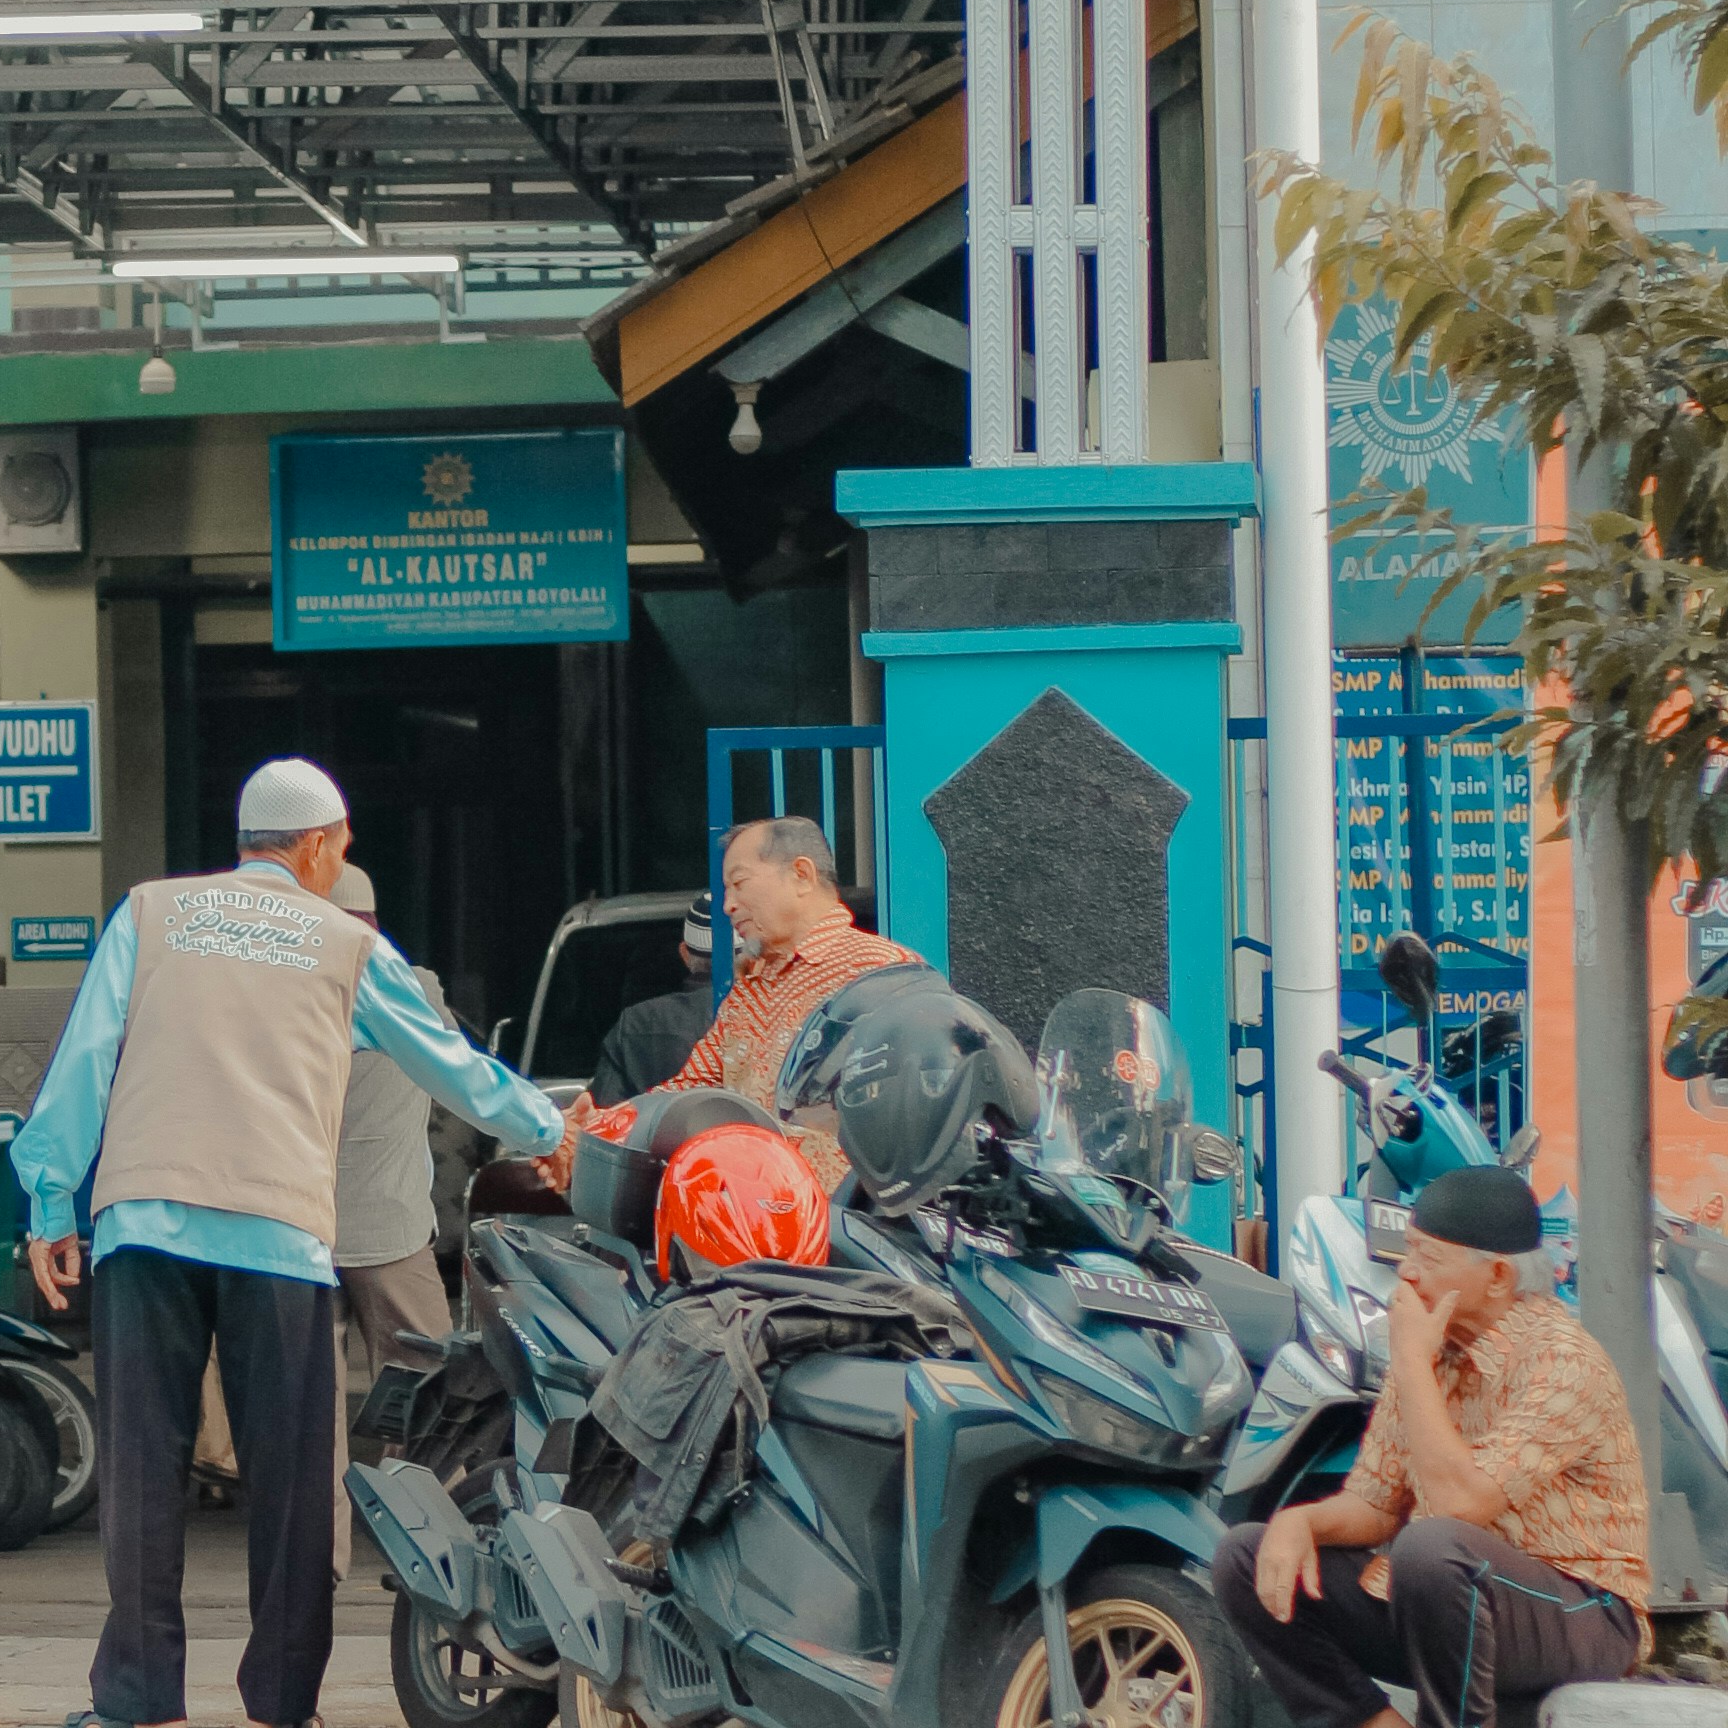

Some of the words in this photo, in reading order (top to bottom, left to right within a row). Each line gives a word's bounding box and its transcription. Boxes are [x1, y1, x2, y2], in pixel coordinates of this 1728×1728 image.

[1357, 406, 1470, 453] MUHAMMADIYAH
[407, 509, 489, 530] KANTOR
[290, 536, 369, 551] KELOMPOK
[373, 533, 457, 550] BIMBINGAN
[460, 532, 516, 547] IBADAH
[519, 530, 555, 545] HAJI
[296, 592, 424, 611] MUHAMMADIYAH
[428, 589, 522, 608] KABUPATEN
[526, 587, 607, 603] BOYOLALI
[1332, 671, 1382, 692] SMP
[174, 889, 254, 912] Kajian
[257, 894, 323, 932] Ahad
[184, 909, 305, 949] Pagimu
[17, 923, 47, 941] AREA
[48, 921, 89, 940] WUDHU
[166, 930, 225, 956] Masjid
[225, 940, 319, 971] Al-Anwar
[1066, 1268, 1099, 1290] AD
[1106, 1277, 1166, 1304] 4241
[1169, 1287, 1208, 1311] DH
[1276, 1355, 1314, 1394] HONDA
